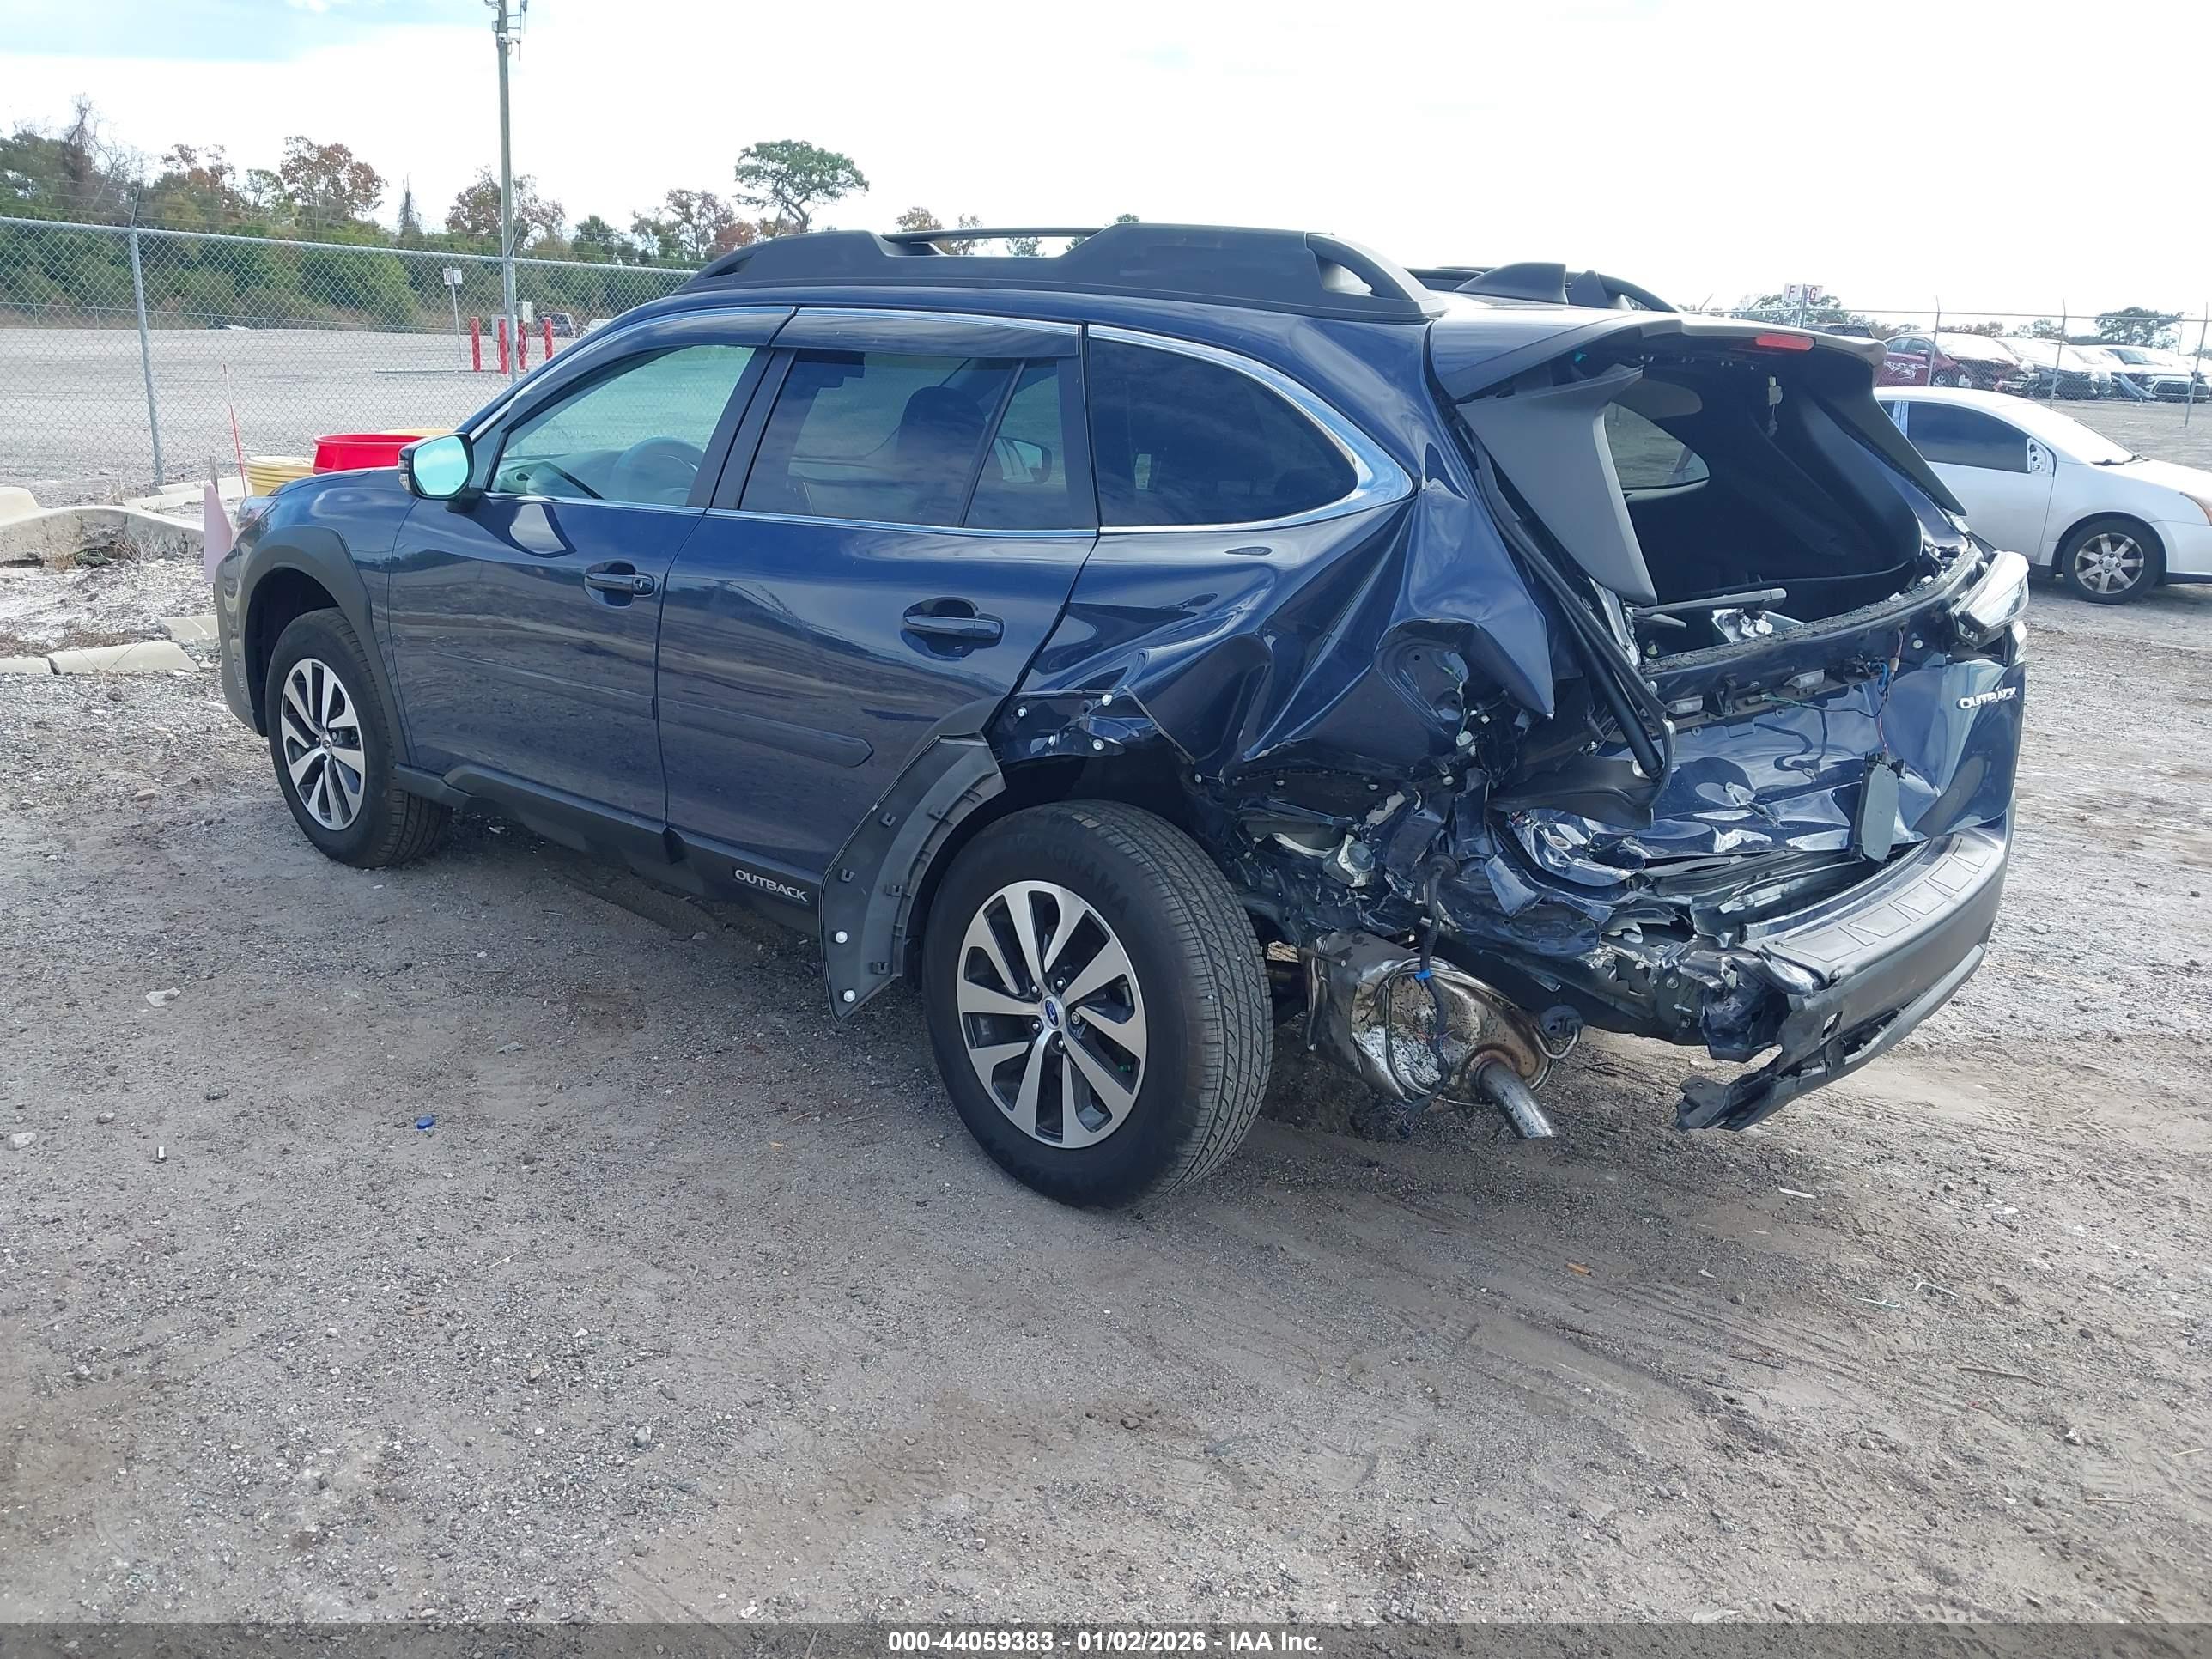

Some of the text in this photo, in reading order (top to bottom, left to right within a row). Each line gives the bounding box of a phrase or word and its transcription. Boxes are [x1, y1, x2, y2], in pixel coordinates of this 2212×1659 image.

[1788, 285, 1796, 299] F
[1808, 287, 1818, 301] G
[734, 869, 808, 902] OUTBACK
